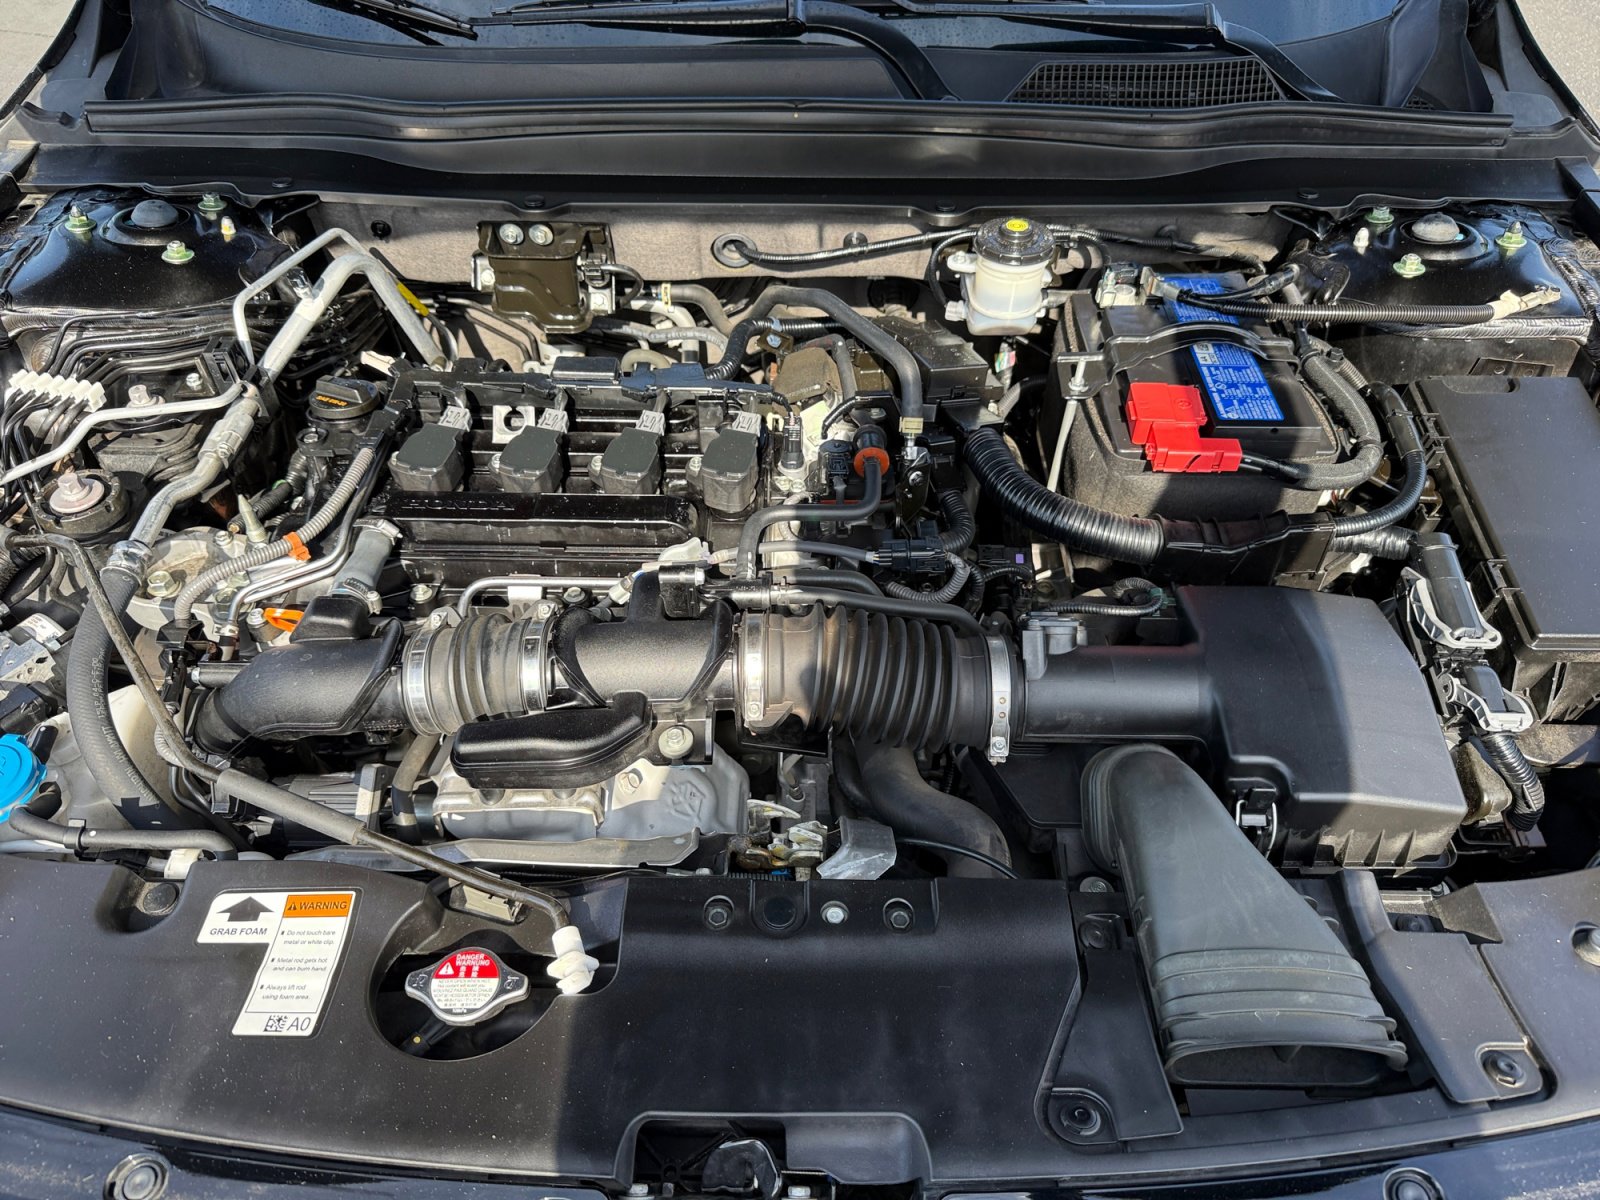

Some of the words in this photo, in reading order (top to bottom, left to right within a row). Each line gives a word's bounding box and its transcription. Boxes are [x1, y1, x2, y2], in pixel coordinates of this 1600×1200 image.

[400, 499, 515, 511] HONDA
[299, 901, 347, 910] WARNING
[209, 928, 237, 936] GRAB
[286, 1016, 312, 1032] A0
